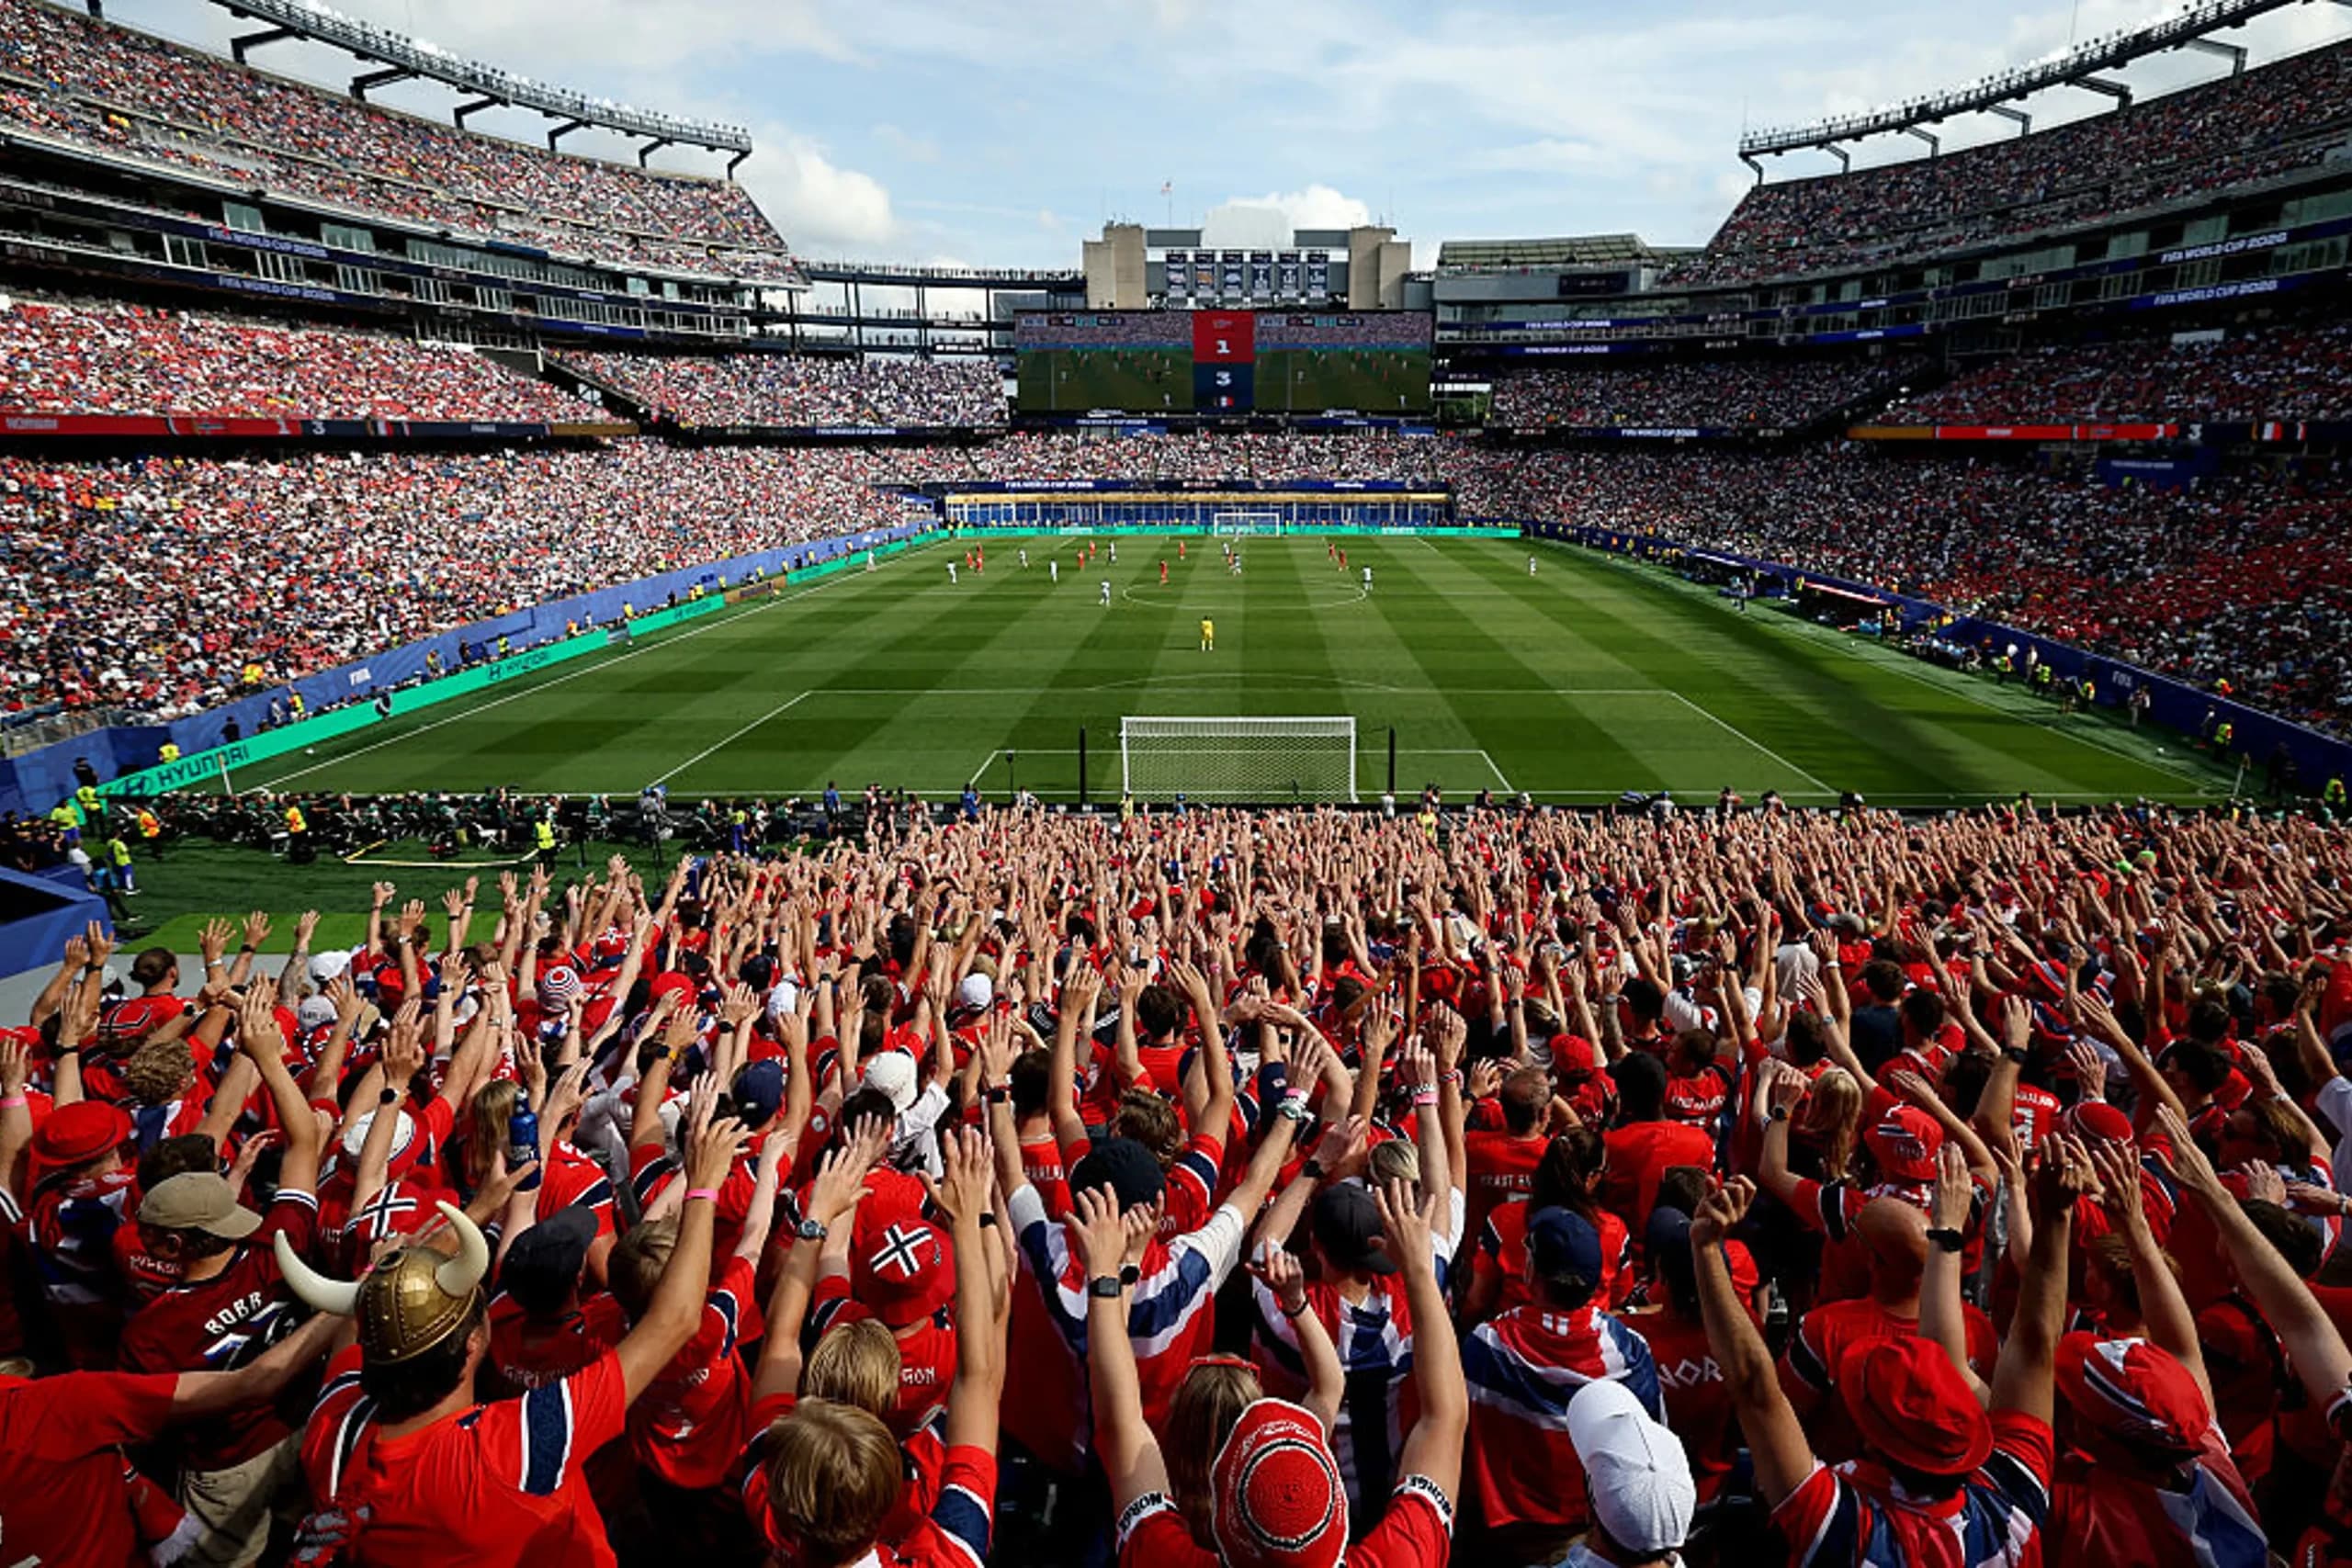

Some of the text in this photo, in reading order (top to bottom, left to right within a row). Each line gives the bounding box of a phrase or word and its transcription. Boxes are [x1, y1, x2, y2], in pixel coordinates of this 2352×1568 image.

[2184, 243, 2222, 260] WORLD
[1216, 339, 1231, 355] 1
[1216, 370, 1232, 386] 3
[277, 419, 325, 435] 1 3
[2188, 423, 2203, 440] 3
[157, 746, 250, 788] HYUNDAI
